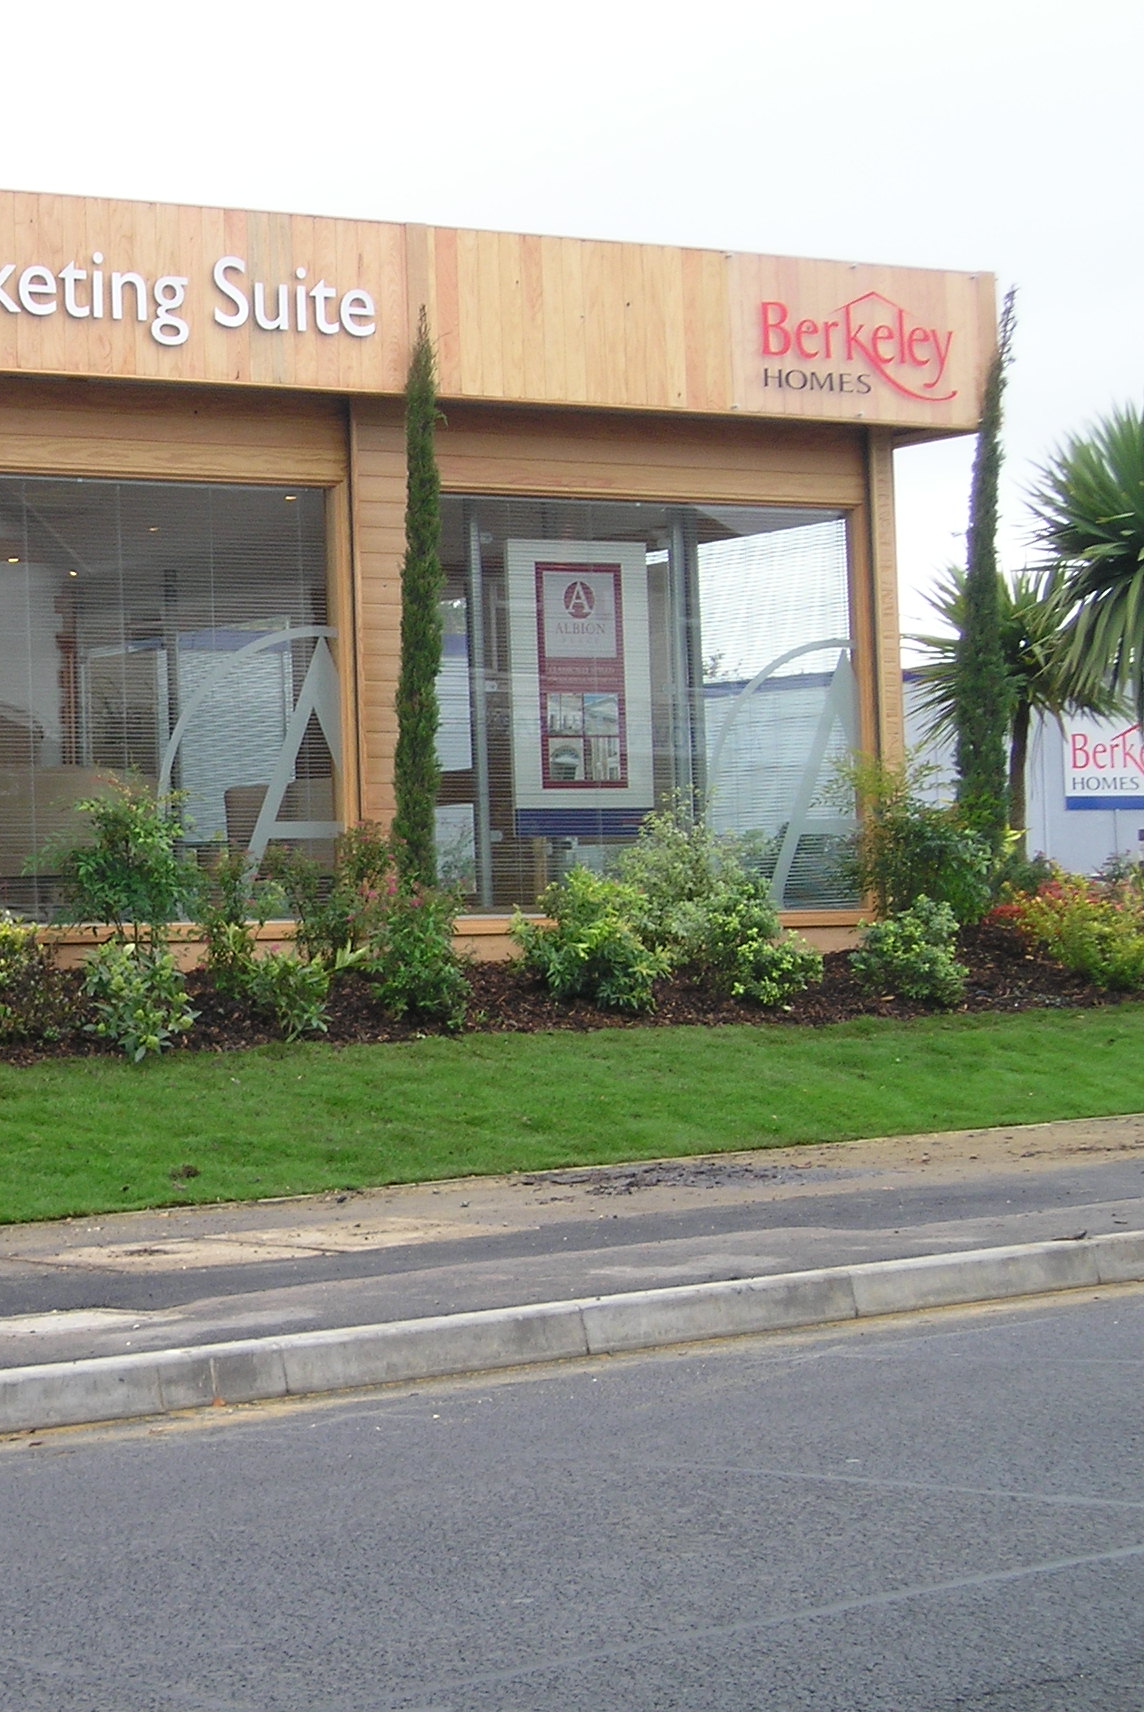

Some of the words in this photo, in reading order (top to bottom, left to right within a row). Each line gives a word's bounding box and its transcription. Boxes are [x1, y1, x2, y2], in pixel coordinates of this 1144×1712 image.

[212, 255, 377, 338] Suite
[760, 299, 957, 402] Berkeley
[762, 367, 873, 396] HOMES
[555, 621, 606, 635] ALBION
[1071, 776, 1140, 791] HOMES
